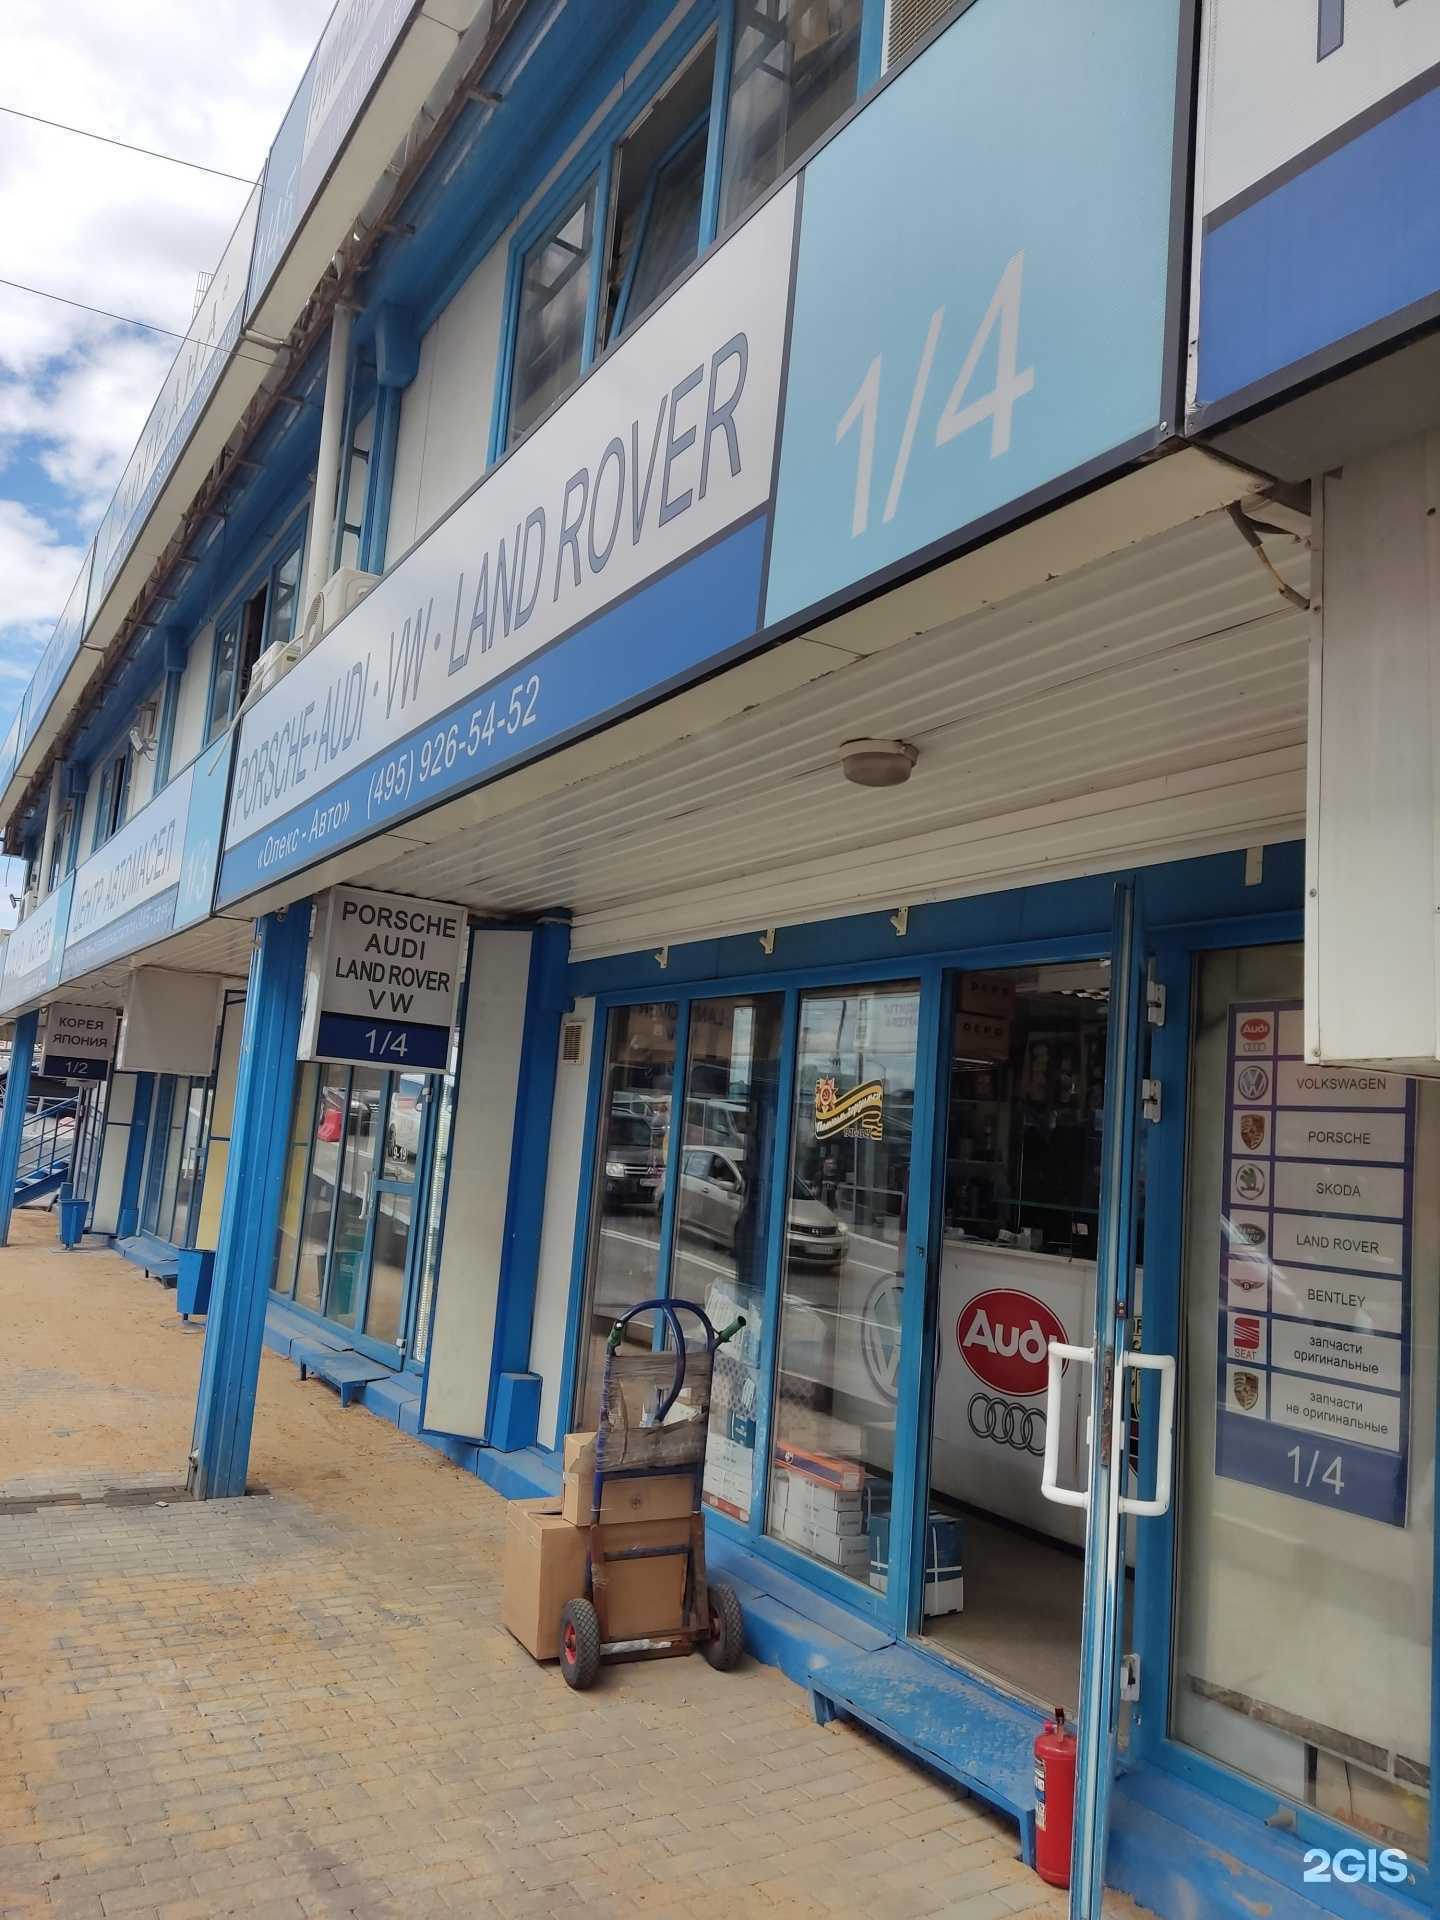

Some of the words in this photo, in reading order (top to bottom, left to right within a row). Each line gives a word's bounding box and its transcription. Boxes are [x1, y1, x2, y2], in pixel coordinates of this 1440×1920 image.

[834, 248, 1035, 539] 1/4
[448, 506, 546, 678] LAND
[553, 331, 749, 603] ROVER
[367, 755, 414, 820] (495)
[419, 674, 541, 782] 926-54-52
[342, 901, 457, 939] PORSCHE
[364, 933, 426, 960] AUDI
[335, 957, 386, 983] LAND
[388, 965, 450, 993] ROVER
[59, 1017, 104, 1030] КОРЕЯ
[1243, 1023, 1268, 1034] Audi
[53, 1034, 107, 1048] ЯПОНИЯ
[365, 1028, 409, 1057] 1/4
[66, 1061, 88, 1074] 1/2
[1296, 1078, 1387, 1090] VOLKSWAGEN
[1308, 1131, 1371, 1145] PORSCHE
[1316, 1183, 1361, 1197] SKODA
[1296, 1234, 1329, 1249] LAND
[1333, 1238, 1380, 1254] ROVER
[1307, 1288, 1366, 1308] BENTLEY
[962, 1308, 1058, 1364] Aud
[1309, 1336, 1363, 1354] запчасти
[1234, 1348, 1257, 1360] SEAT
[1293, 1350, 1379, 1374] оригинальные
[1309, 1392, 1363, 1412] запчасти
[1286, 1403, 1299, 1414] не
[1302, 1407, 1389, 1434] оригинальные
[1287, 1445, 1345, 1495] 1/4
